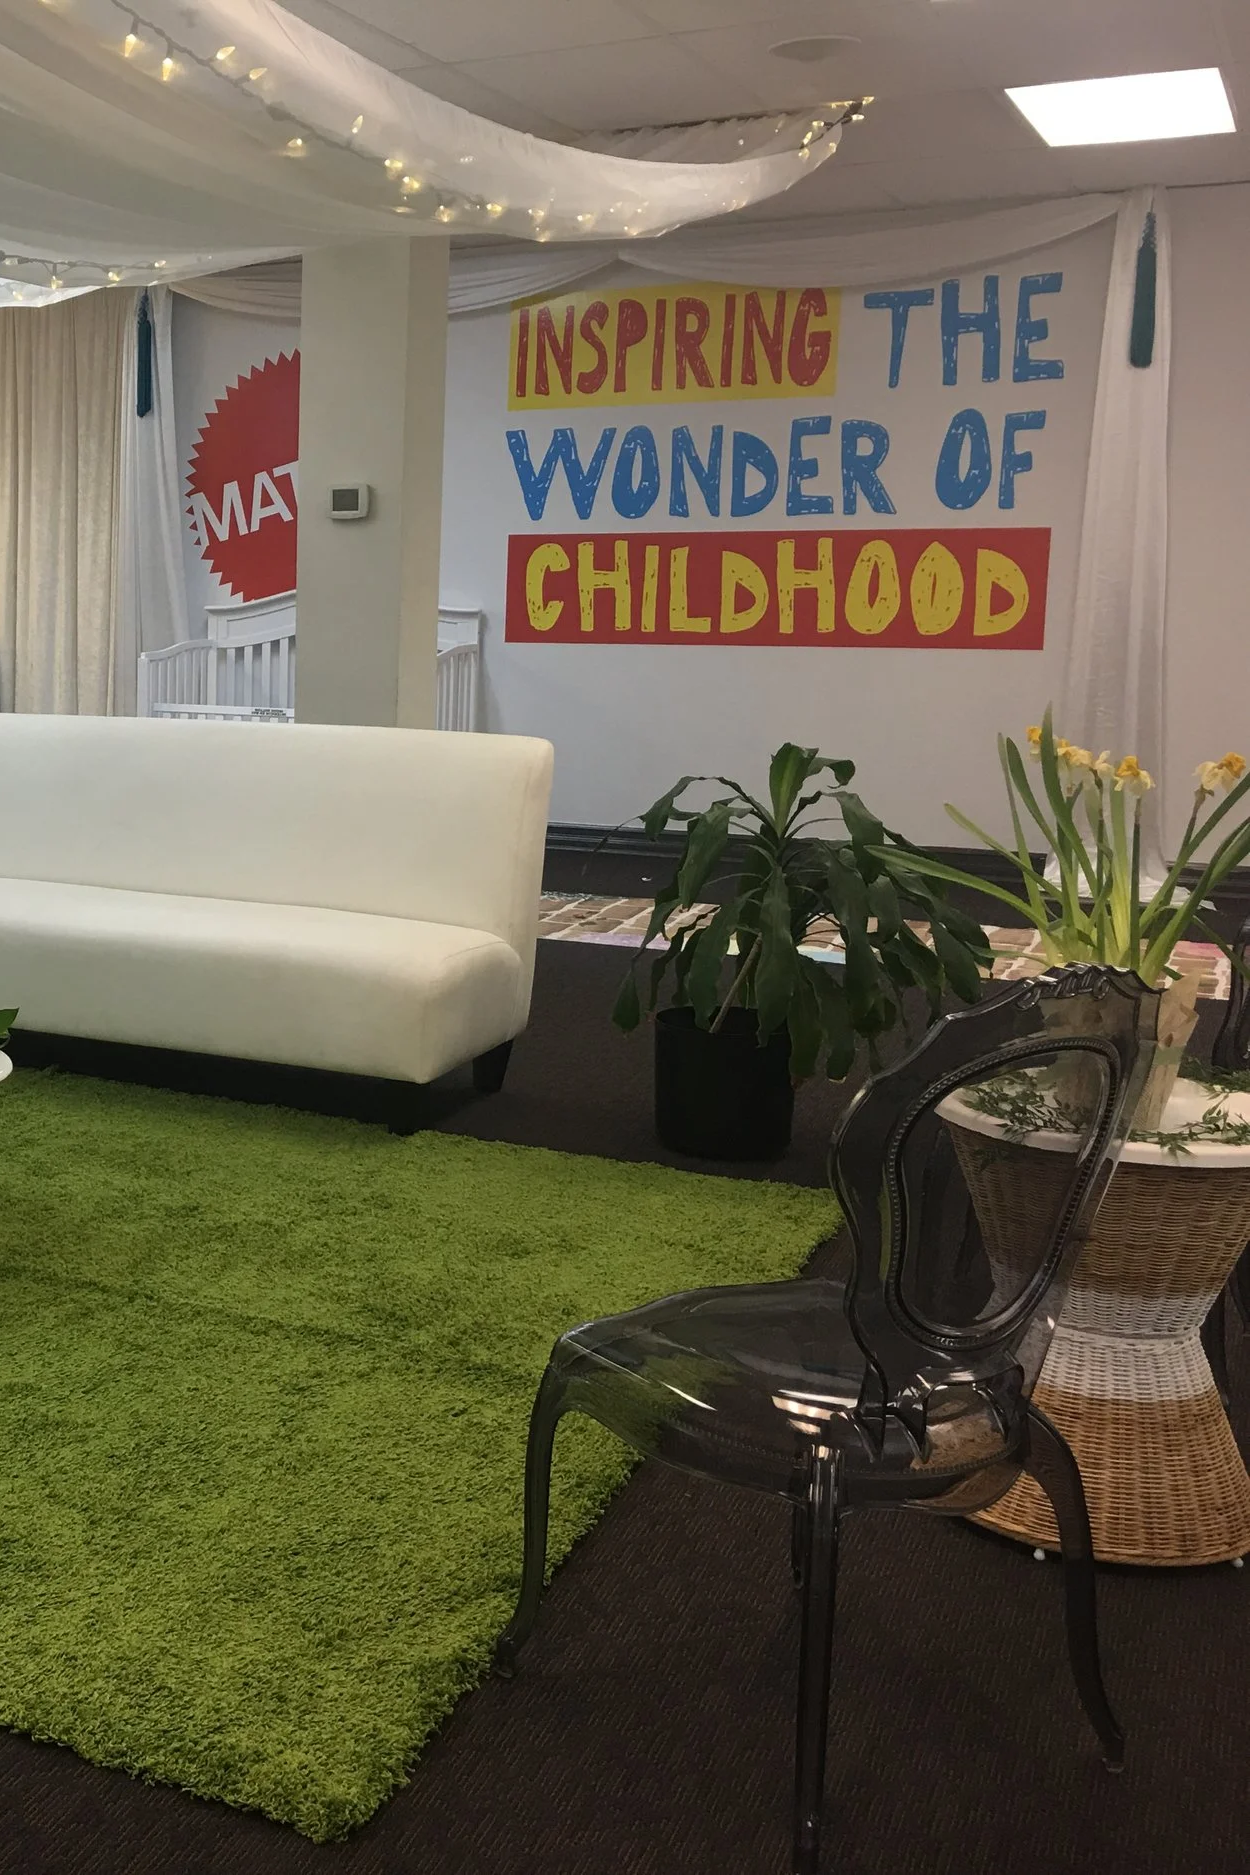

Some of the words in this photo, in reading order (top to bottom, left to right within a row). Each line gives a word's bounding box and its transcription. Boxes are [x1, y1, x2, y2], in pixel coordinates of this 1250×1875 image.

[516, 288, 832, 397] INSPIRING
[864, 272, 1065, 388] THE
[505, 416, 897, 521] WONDER
[935, 408, 1046, 510] OF
[526, 537, 1029, 636] CHILDHOOD
